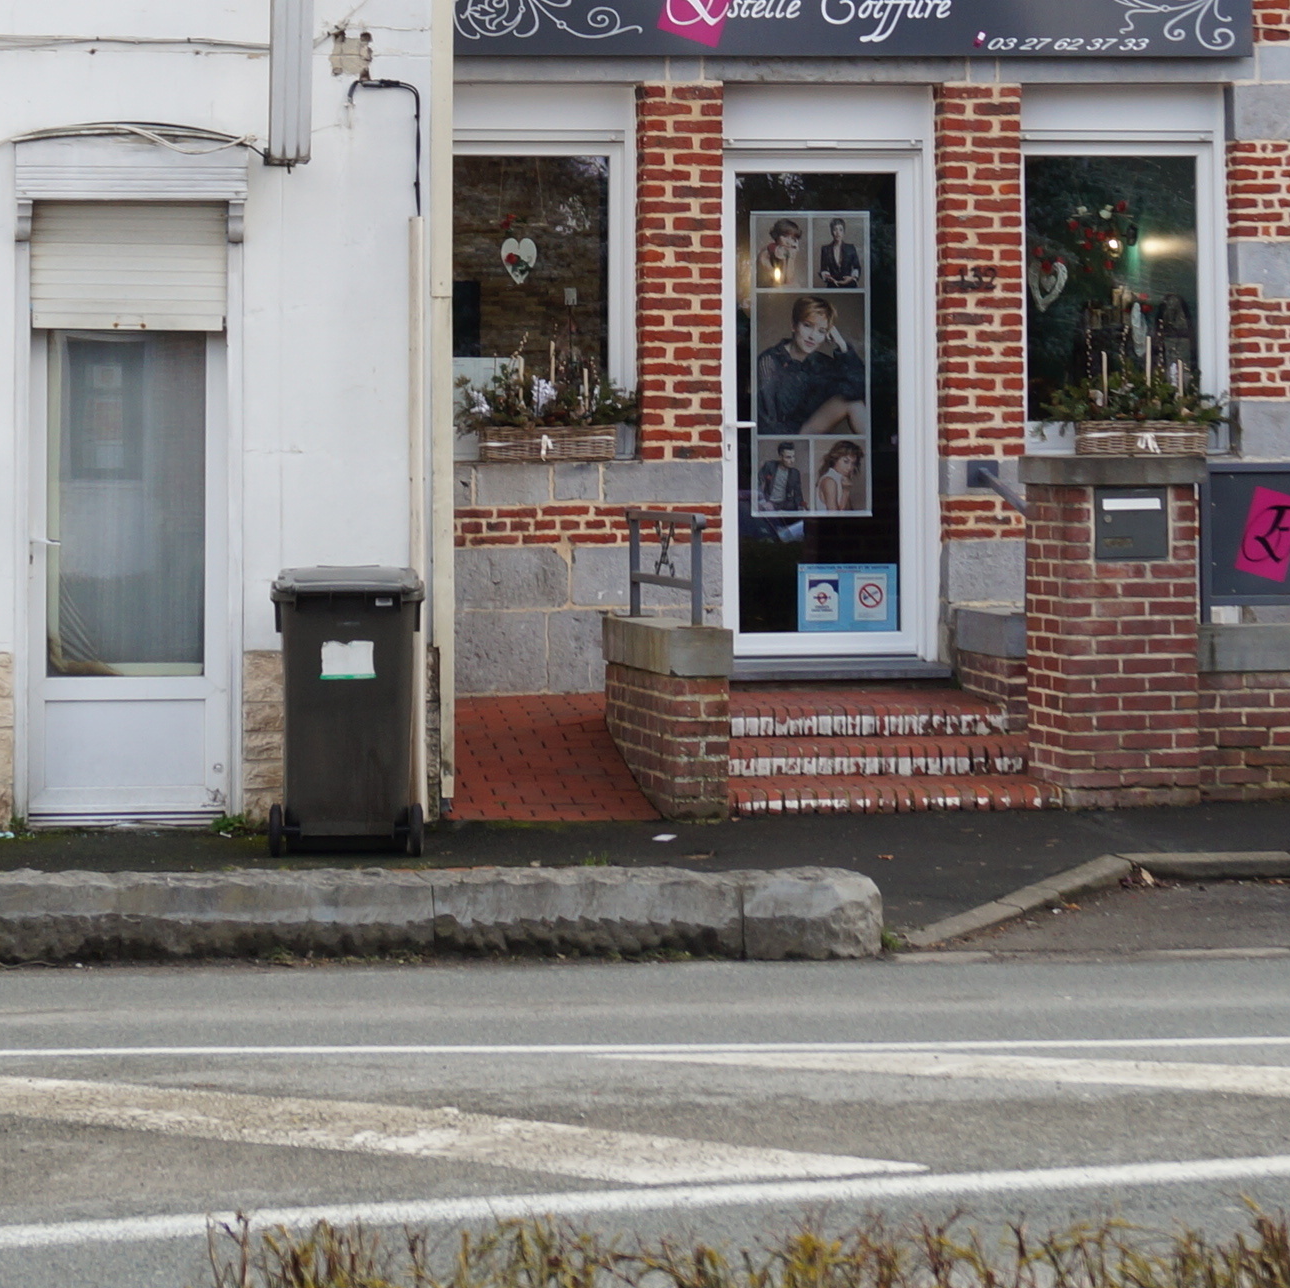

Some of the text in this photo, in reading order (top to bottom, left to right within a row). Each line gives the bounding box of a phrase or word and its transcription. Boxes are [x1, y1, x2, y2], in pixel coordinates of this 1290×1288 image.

[987, 37, 1150, 51] 03 27 62 37 33
